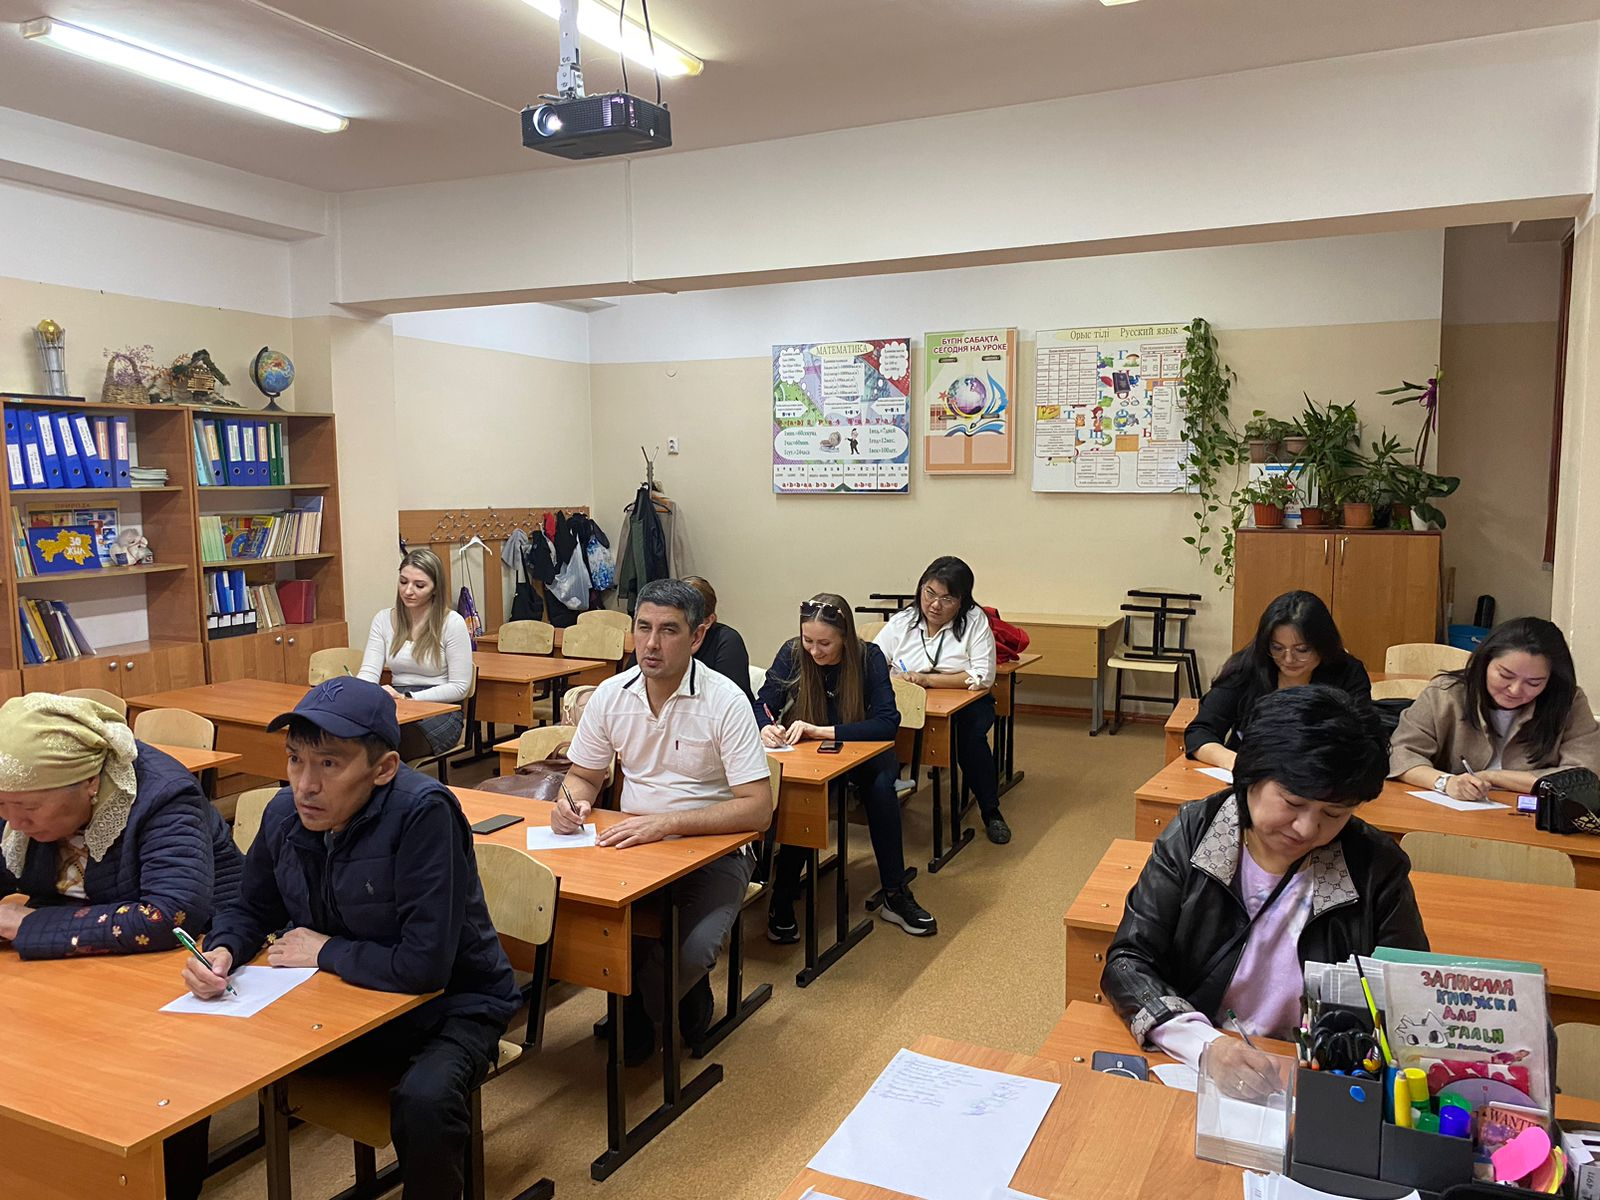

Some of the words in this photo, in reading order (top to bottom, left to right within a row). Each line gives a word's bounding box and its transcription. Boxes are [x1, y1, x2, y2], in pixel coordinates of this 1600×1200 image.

[1070, 330, 1091, 340] Орыс
[1094, 328, 1110, 338] тілі
[1120, 327, 1154, 338] Русский
[1156, 327, 1179, 336] язык
[942, 337, 963, 345] БҮГІН
[964, 335, 999, 343] САБАҚТА
[816, 344, 868, 355] МАТЕМАТИКА
[934, 345, 968, 353] СЕГОДНЯ
[970, 344, 981, 352] НА
[983, 343, 1007, 351] УРОКЕ
[1436, 989, 1517, 1012] КНИЖКА
[1443, 1005, 1476, 1022] ДЛЯ
[1490, 1108, 1545, 1131] WANT
